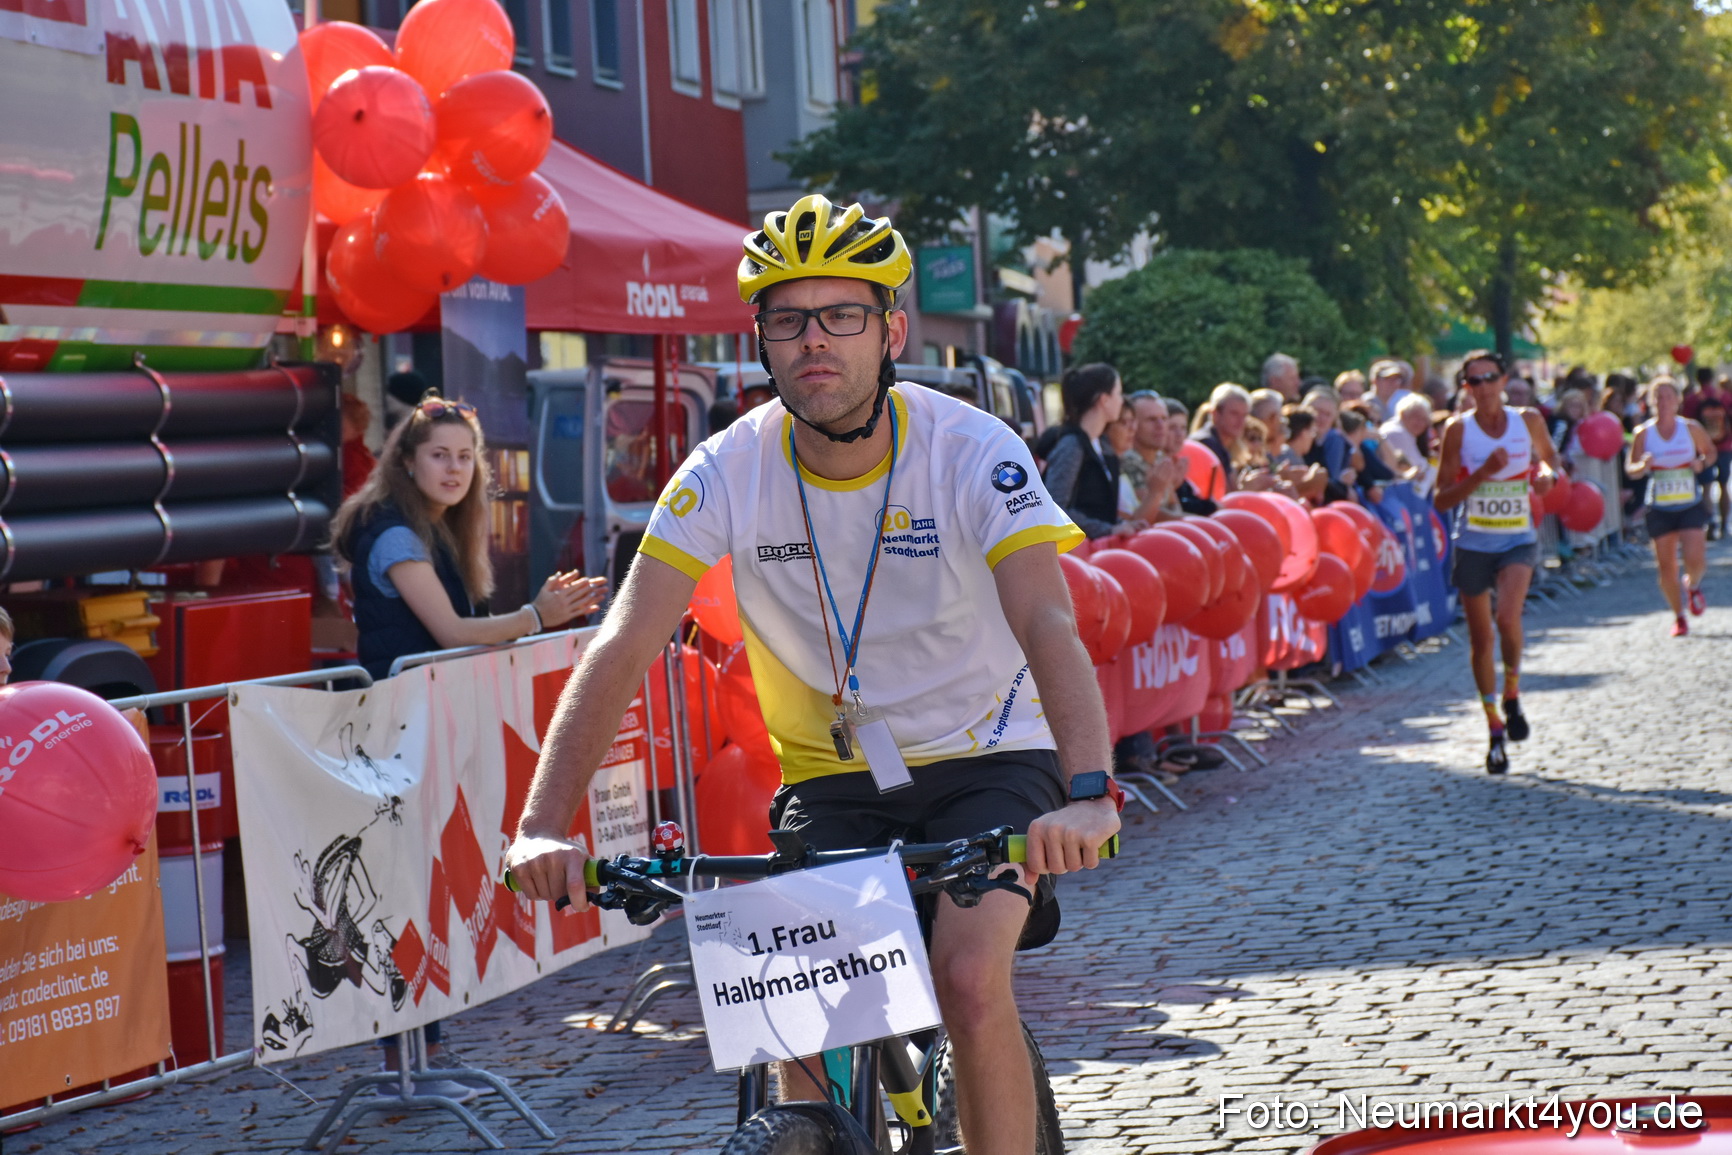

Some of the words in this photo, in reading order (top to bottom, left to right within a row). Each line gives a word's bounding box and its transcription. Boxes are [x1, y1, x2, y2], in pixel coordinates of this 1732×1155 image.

[102, 0, 273, 109] AVIA
[94, 111, 274, 264] Pellets
[1005, 490, 1040, 510] PARTL
[1477, 499, 1523, 516] 1003
[882, 532, 940, 545] Neumarkt
[883, 511, 910, 532] 20
[993, 686, 1018, 737] September
[44, 716, 93, 750] energie
[21, 951, 36, 974] Sie
[39, 942, 63, 968] sich
[66, 938, 86, 962] bei
[88, 935, 119, 957] uns:
[747, 919, 837, 956] 1.Frau
[21, 965, 109, 1006] codeclinic.de
[713, 947, 907, 1007] Halbmarathon
[8, 1013, 49, 1043] 09181
[50, 1002, 93, 1031] 8833
[94, 995, 120, 1021] 897
